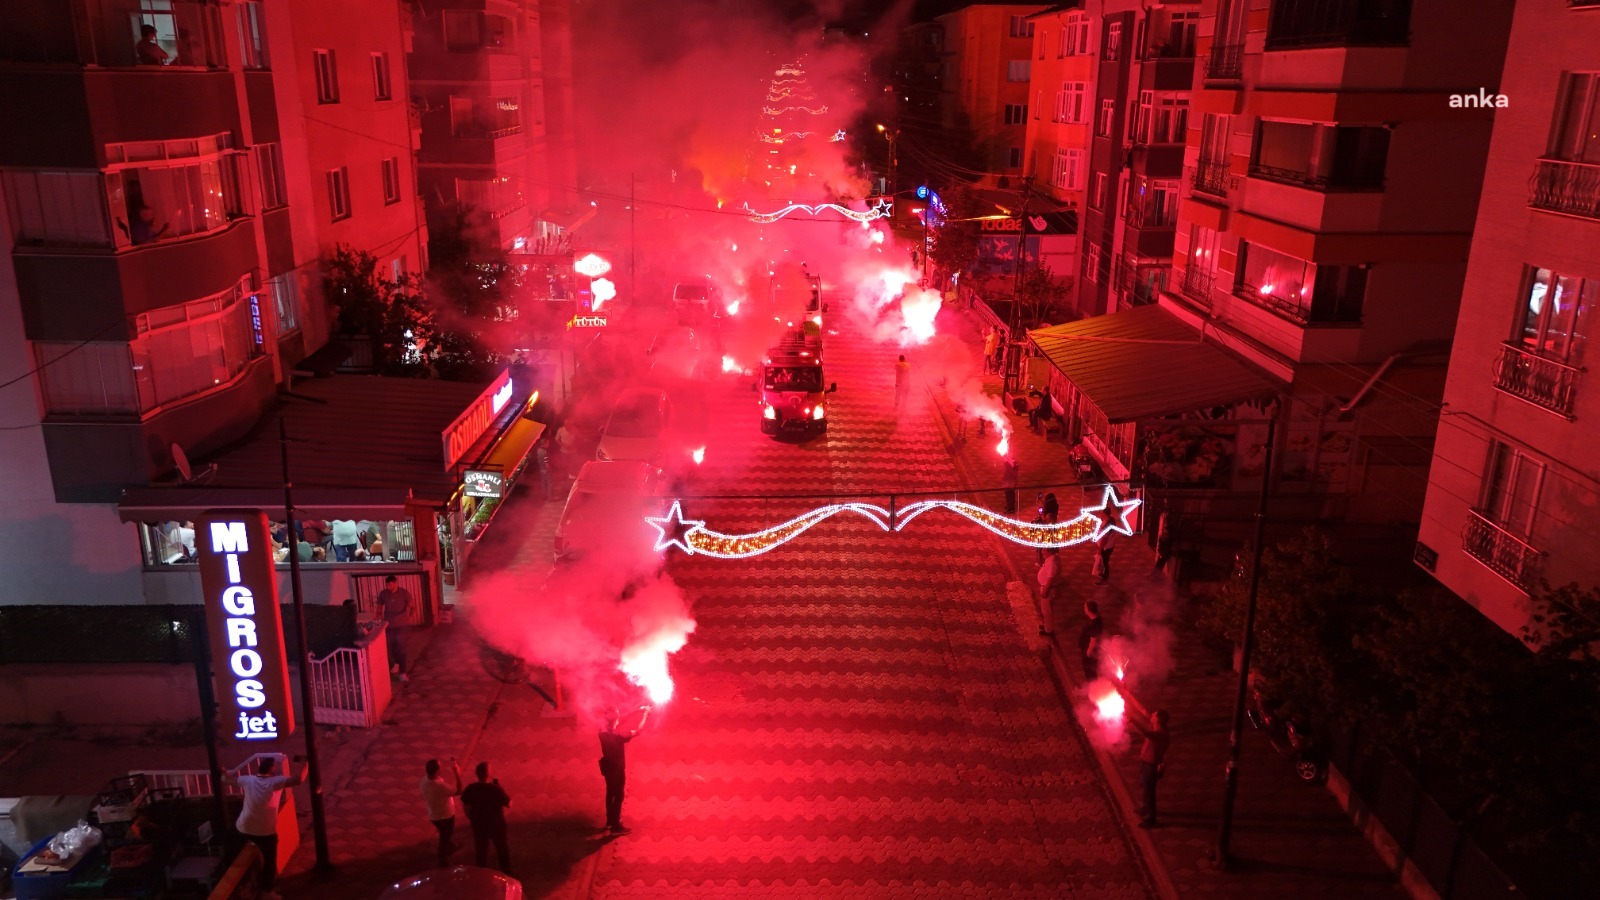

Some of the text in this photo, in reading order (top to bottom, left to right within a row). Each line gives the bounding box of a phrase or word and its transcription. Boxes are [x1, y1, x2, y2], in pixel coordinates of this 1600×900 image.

[576, 316, 607, 327] TÜTÜN
[465, 472, 502, 486] OSMANLI
[210, 522, 266, 708] MIGROS
[235, 710, 278, 739] jet
